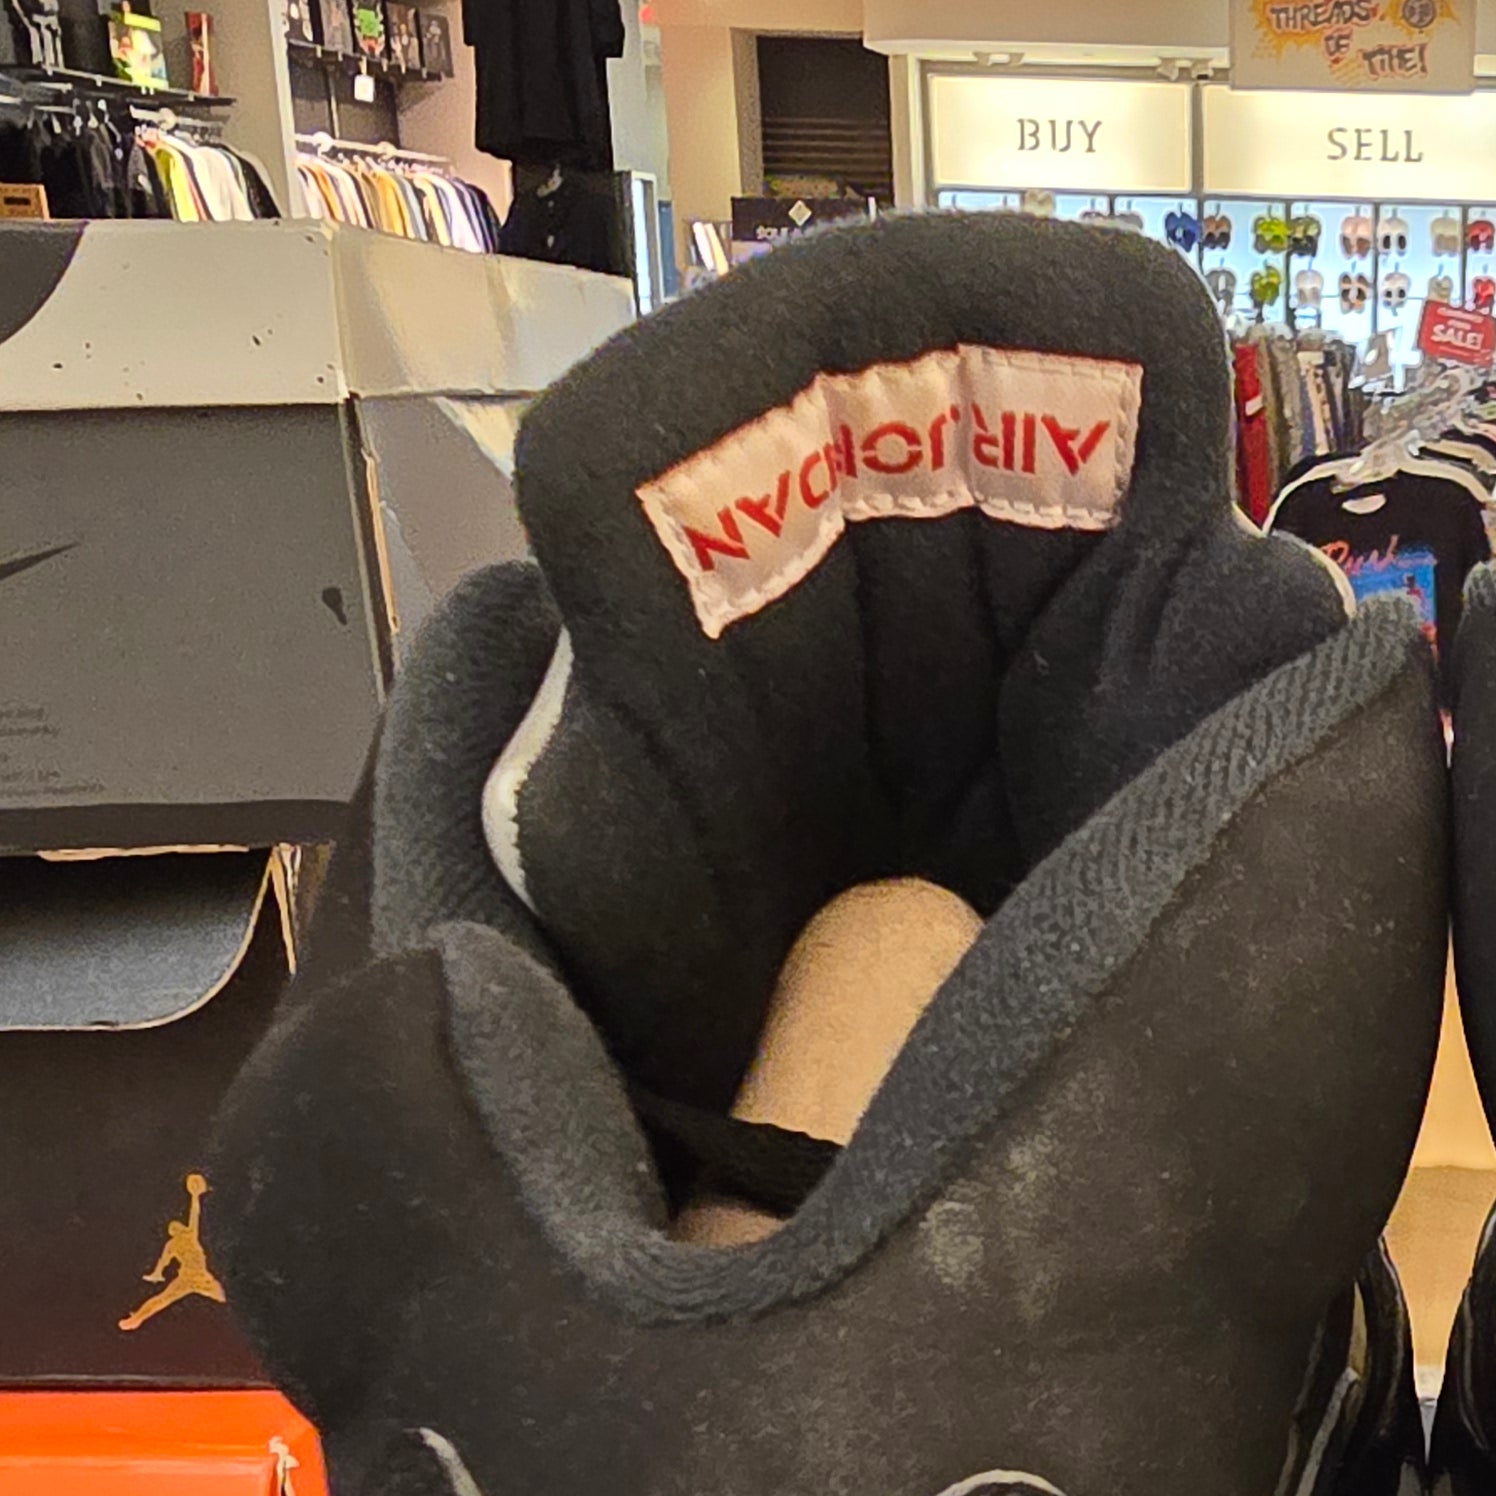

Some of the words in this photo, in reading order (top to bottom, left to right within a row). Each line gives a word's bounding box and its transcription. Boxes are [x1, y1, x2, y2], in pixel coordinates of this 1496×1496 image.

[1016, 118, 1103, 153] BUY
[1326, 127, 1424, 164] SELL
[970, 402, 1111, 476] AIR
